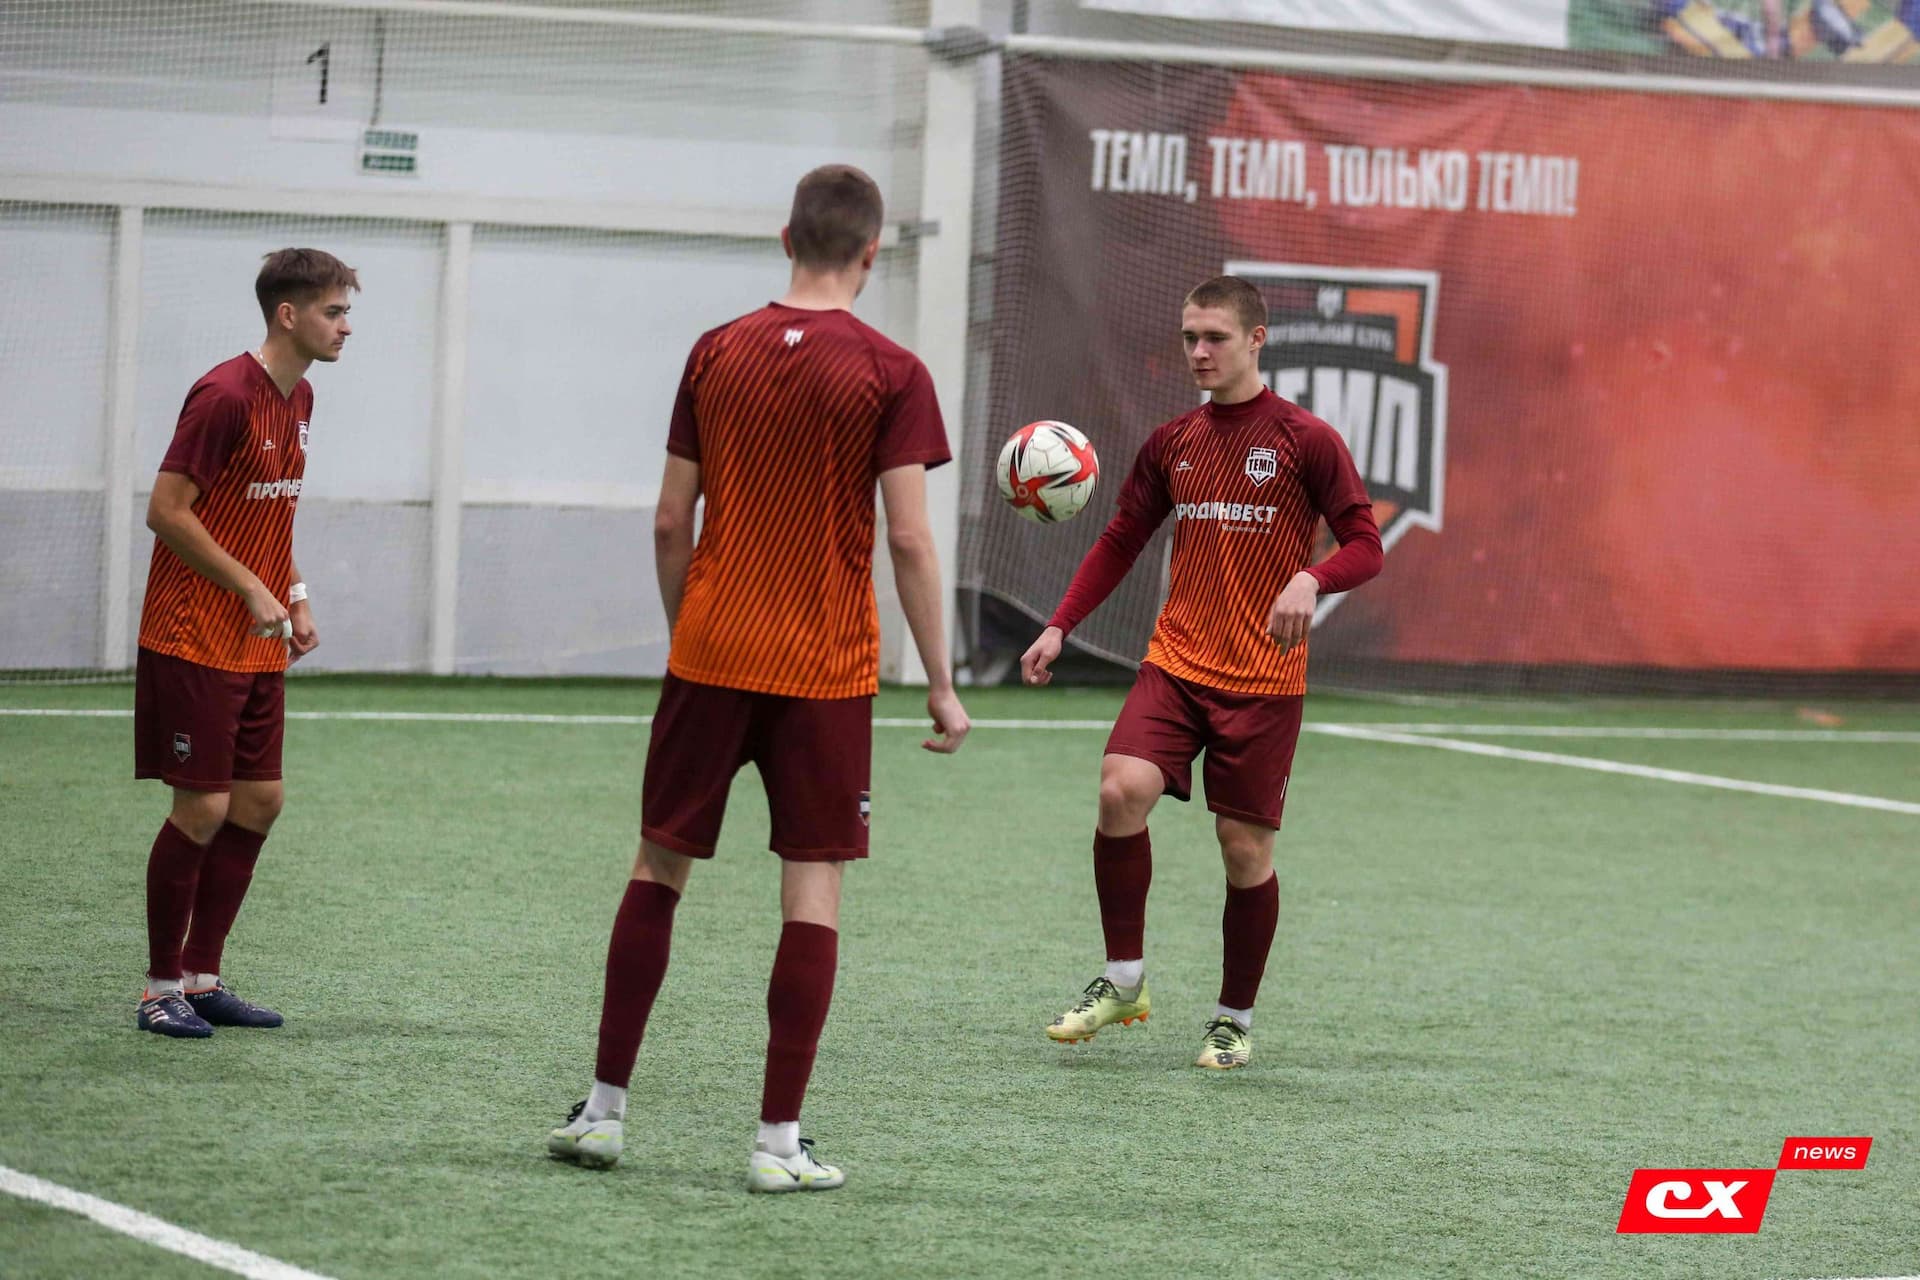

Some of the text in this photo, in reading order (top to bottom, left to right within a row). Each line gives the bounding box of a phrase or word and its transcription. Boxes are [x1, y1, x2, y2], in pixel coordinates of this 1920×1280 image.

[306, 41, 330, 105] 1
[1090, 129, 1579, 217] ТЕМП, ТЕМП, ТОЛЬКО ТЕМП!
[1248, 458, 1275, 475] ТЕМП
[1175, 501, 1277, 524] РОДИНВЕСТ
